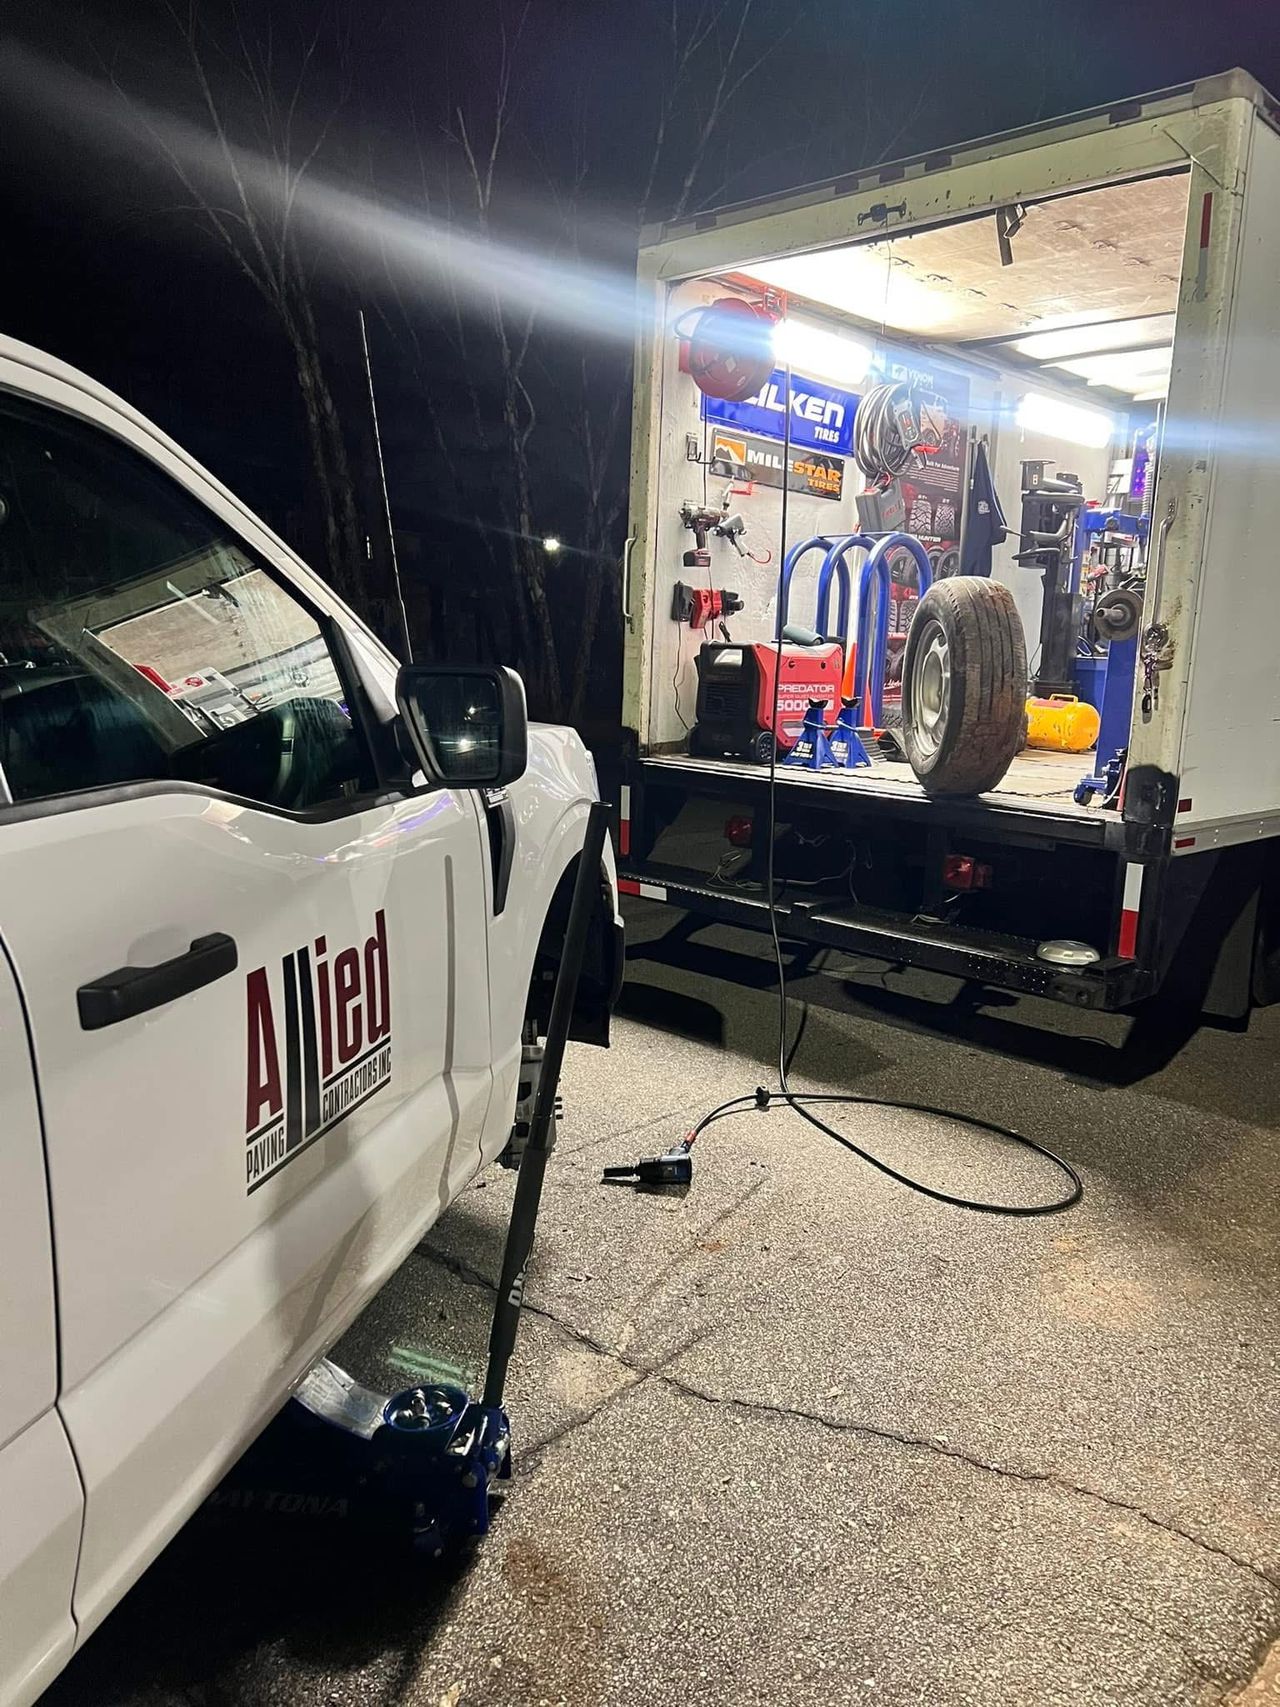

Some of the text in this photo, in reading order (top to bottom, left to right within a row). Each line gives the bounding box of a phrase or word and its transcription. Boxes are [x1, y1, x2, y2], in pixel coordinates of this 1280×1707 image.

[743, 383, 845, 428] ALKEN
[814, 426, 840, 443] TIRES
[747, 449, 842, 482] MILESTAR
[808, 478, 840, 492] TIRES
[777, 684, 835, 693] PREDATOR
[246, 909, 390, 1153] Allied
[247, 1046, 392, 1183] PAVING CONTRACTORS INC
